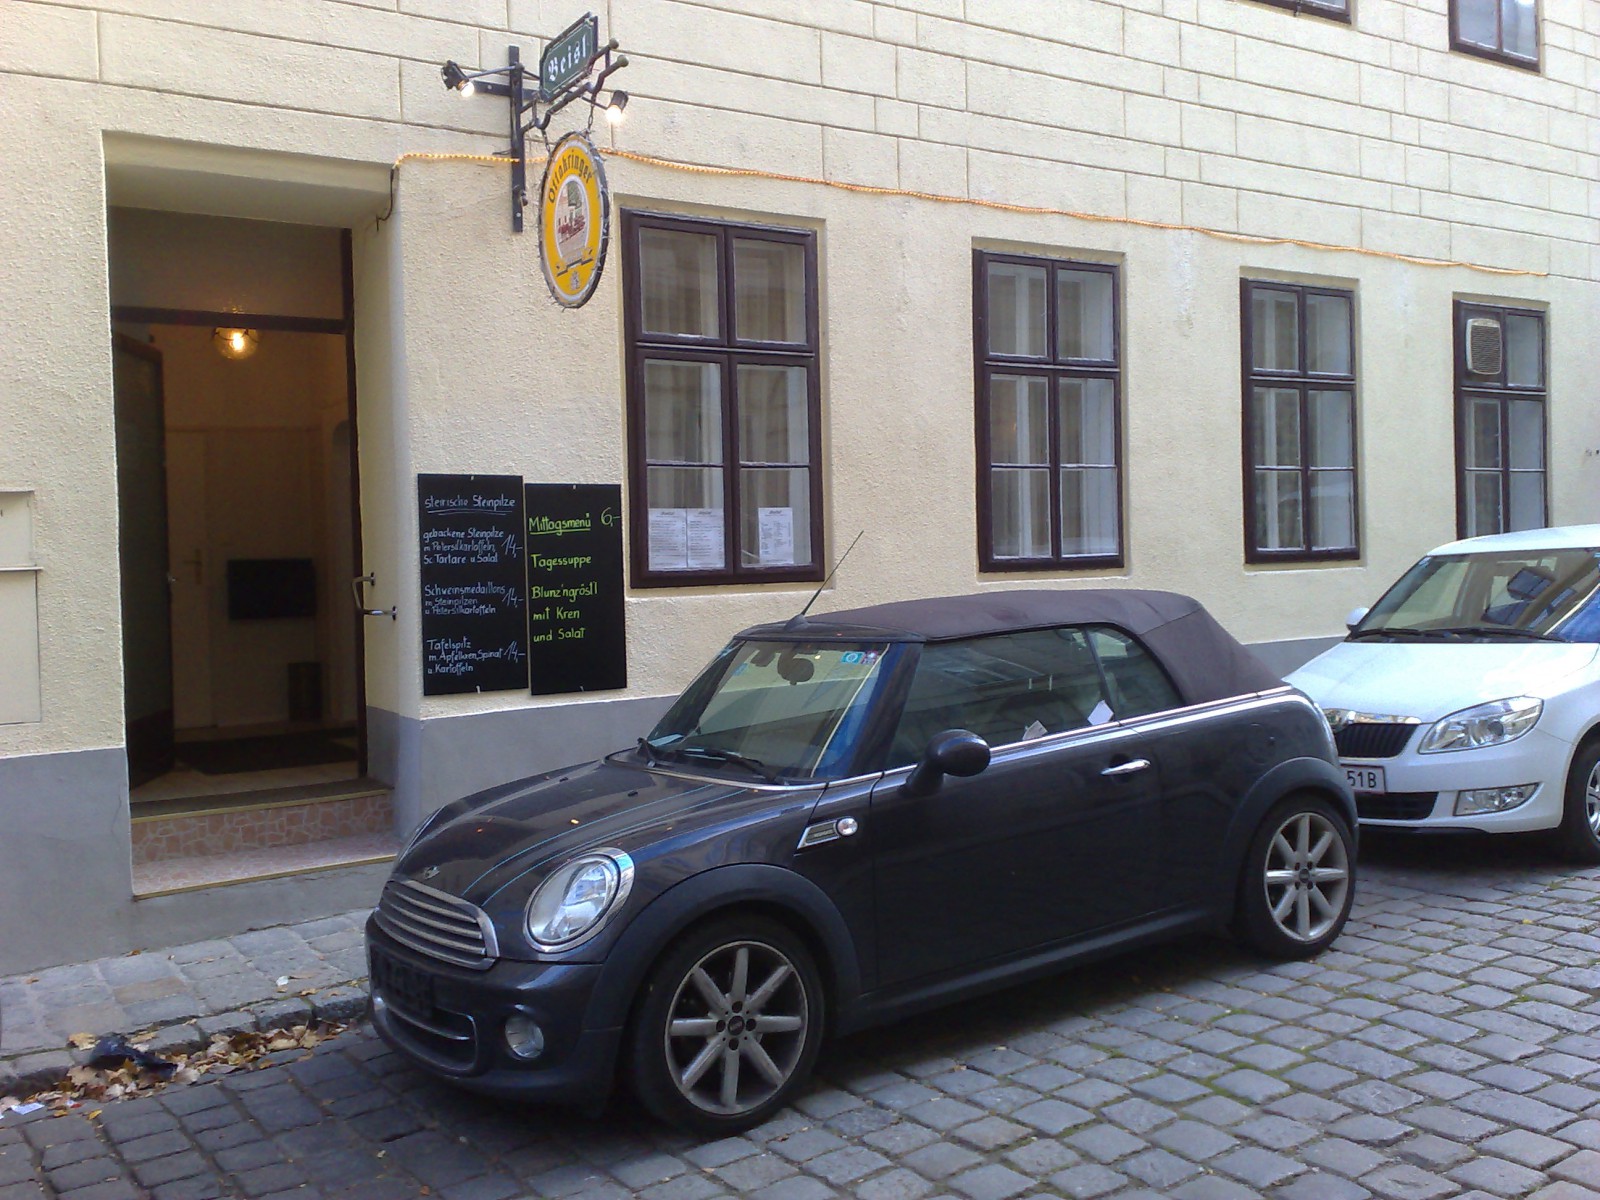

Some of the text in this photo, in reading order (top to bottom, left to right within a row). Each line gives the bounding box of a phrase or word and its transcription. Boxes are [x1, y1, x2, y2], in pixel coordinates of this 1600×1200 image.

[549, 149, 592, 203] Ottakringer
[473, 494, 515, 511] Steinpilze
[423, 526, 504, 542] gebackene Steinpilze
[434, 553, 466, 564] Tartare
[477, 552, 498, 563] Salat
[531, 554, 591, 571] Tagessuppe
[533, 607, 580, 620] mit Kren
[533, 628, 586, 642] und Salat
[426, 636, 471, 653] Tafelspitz
[435, 662, 474, 676] Kartoffeln
